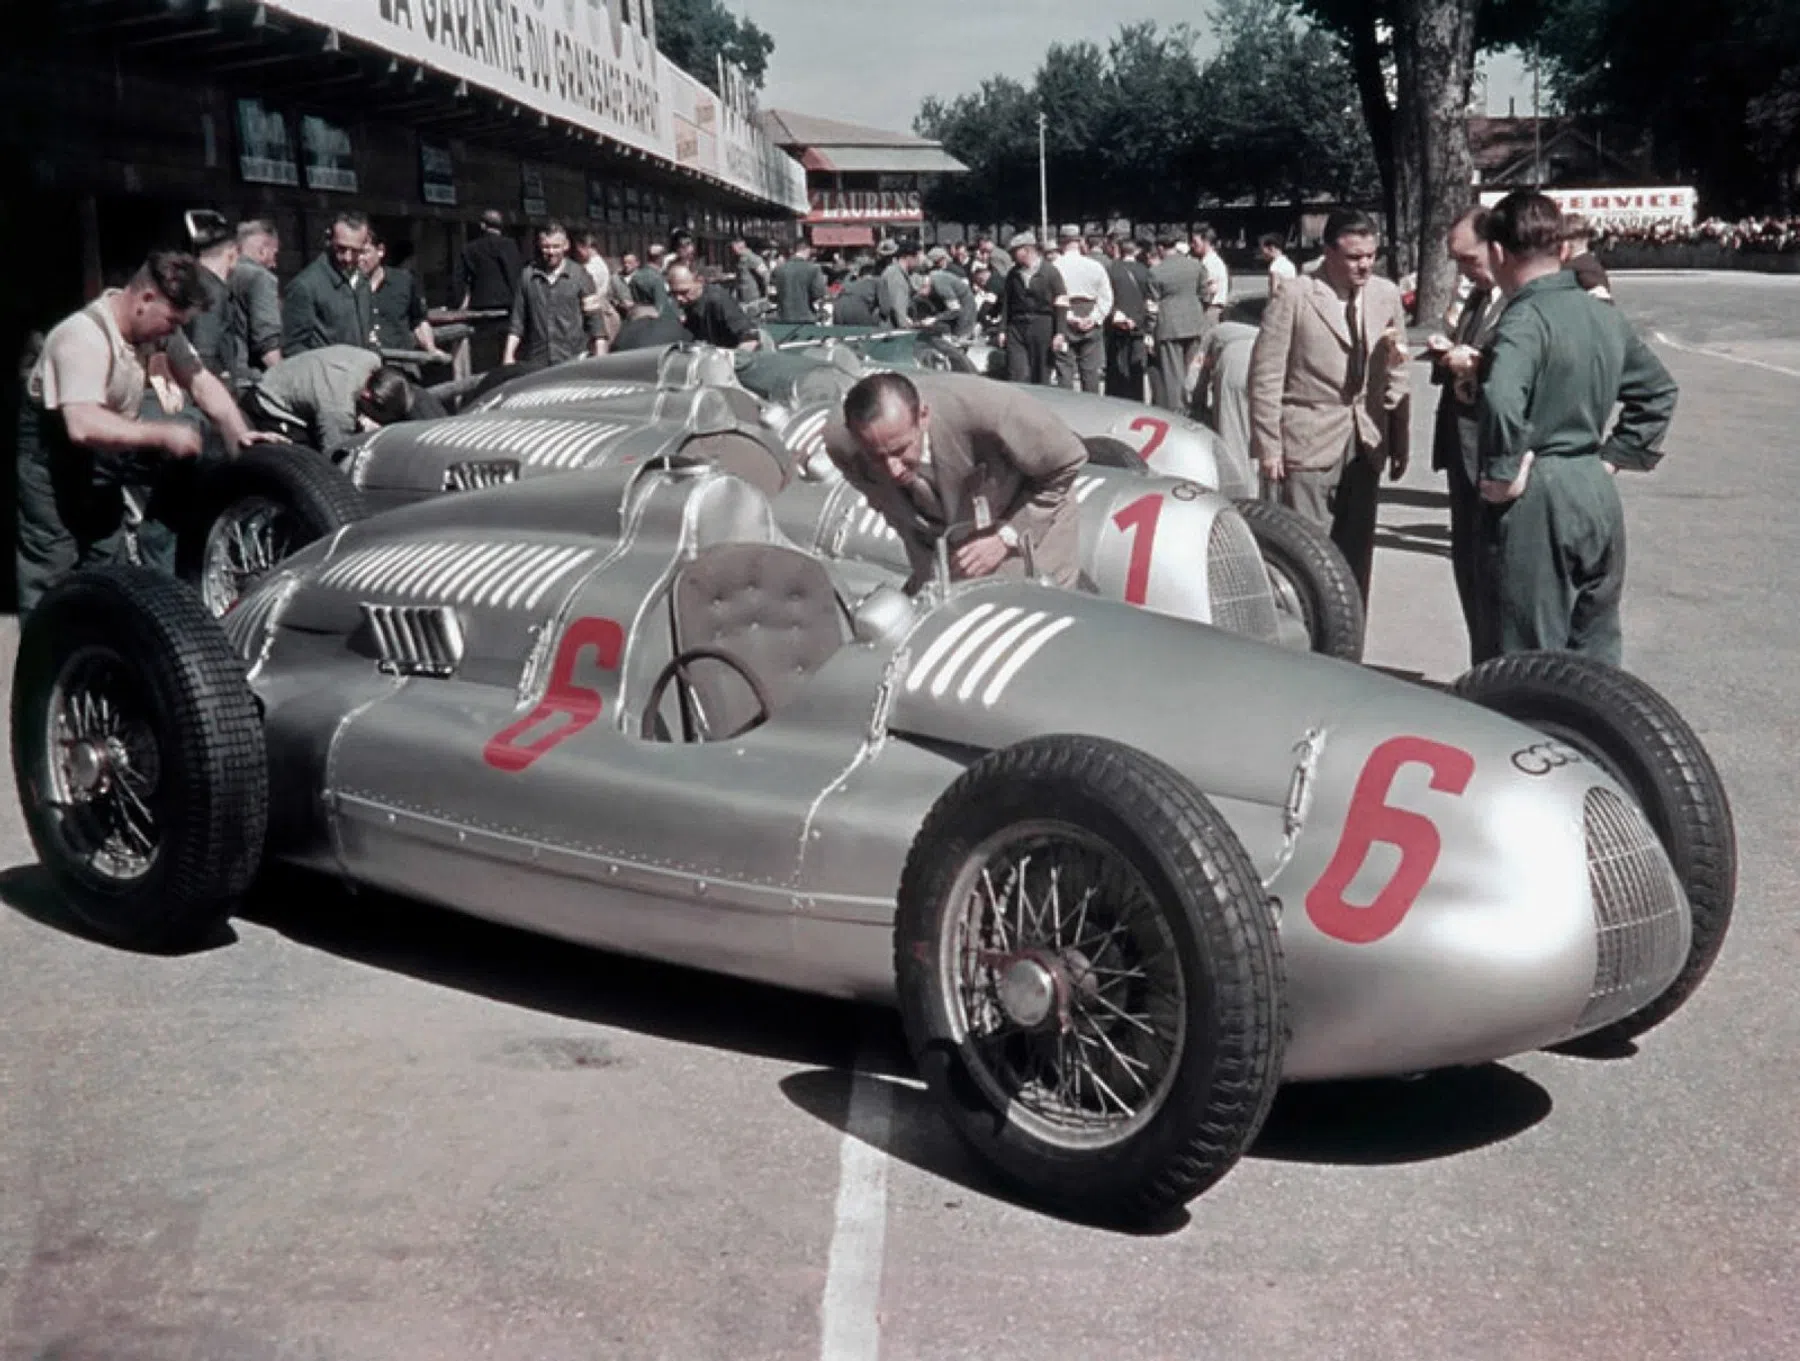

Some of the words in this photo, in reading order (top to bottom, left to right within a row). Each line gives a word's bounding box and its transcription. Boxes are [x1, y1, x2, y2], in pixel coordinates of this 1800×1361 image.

[525, 14, 551, 93] DU
[823, 191, 921, 218] LAURENS
[1112, 492, 1164, 606] 1
[483, 615, 626, 772] 6
[1304, 735, 1476, 944] 6
